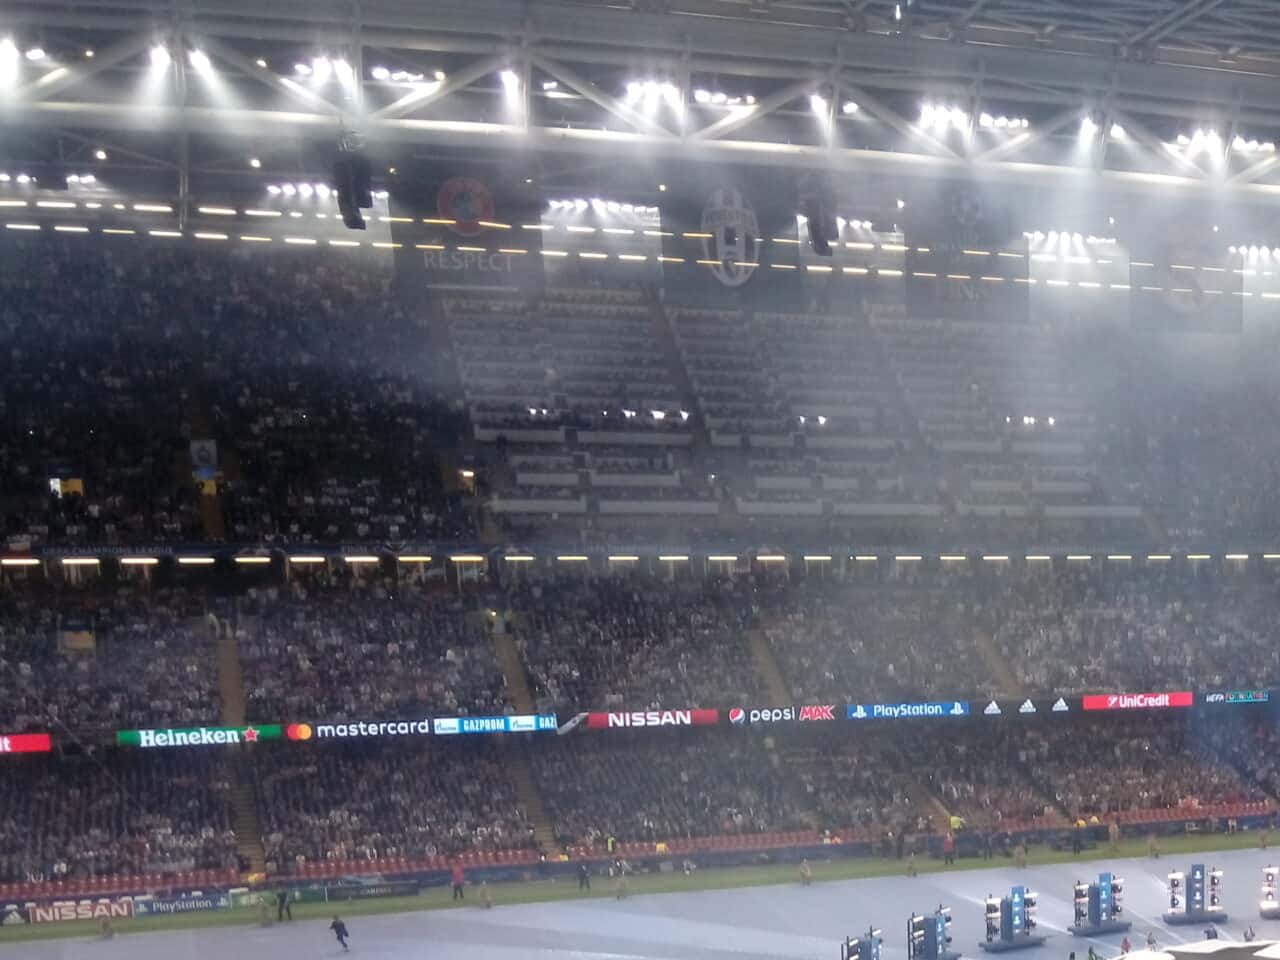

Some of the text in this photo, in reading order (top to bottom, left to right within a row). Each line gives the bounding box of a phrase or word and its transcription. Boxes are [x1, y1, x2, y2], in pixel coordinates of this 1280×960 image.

[423, 251, 513, 272] RESPECT
[1119, 694, 1169, 709] UniCredit
[607, 710, 691, 728] NISSAN
[750, 705, 834, 724] pepsi MAX
[873, 704, 943, 718] PlayStation
[316, 719, 429, 740] mastercard
[463, 717, 505, 733] GAZPROM
[140, 727, 240, 748] Heineken
[35, 904, 129, 922] NISSAN
[152, 899, 212, 913] PlayStation
